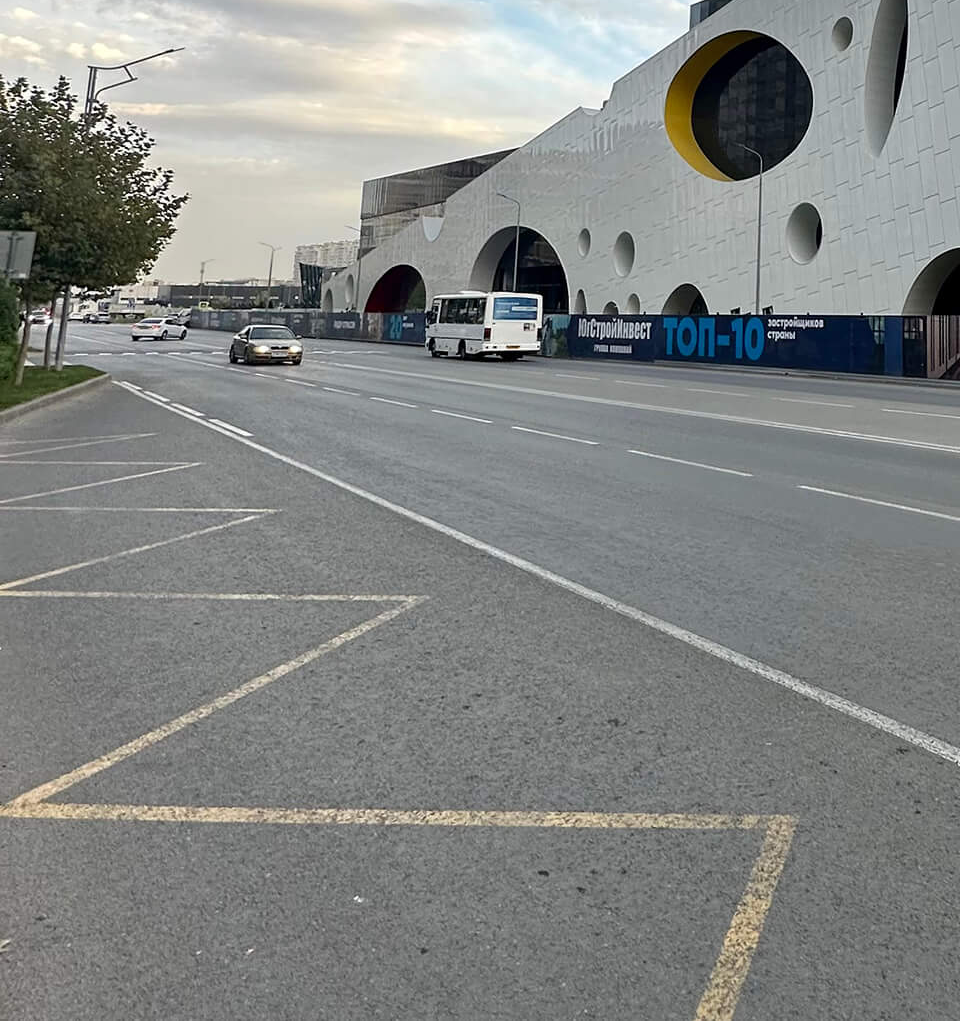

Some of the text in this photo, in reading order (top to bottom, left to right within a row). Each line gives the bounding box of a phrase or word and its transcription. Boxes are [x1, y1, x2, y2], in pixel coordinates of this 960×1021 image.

[578, 317, 652, 340] ЮгСтройИнвест
[767, 316, 824, 329] застройщиков
[663, 316, 765, 361] ТОП-10
[767, 330, 796, 342] страны
